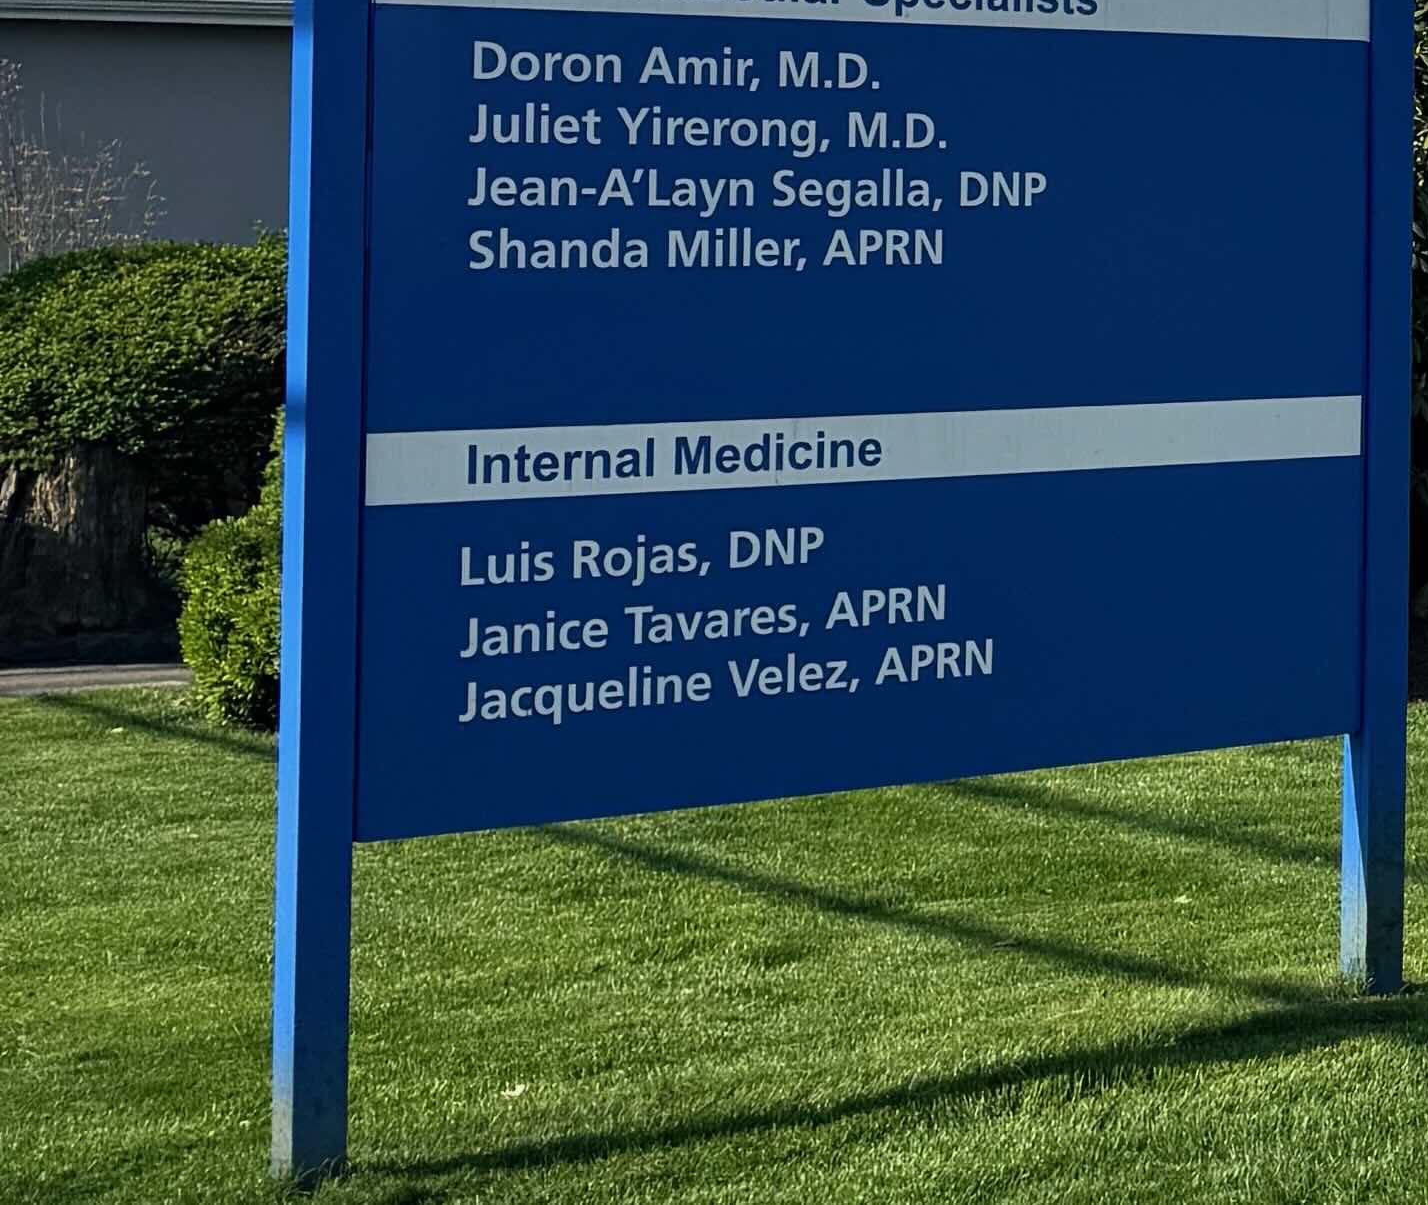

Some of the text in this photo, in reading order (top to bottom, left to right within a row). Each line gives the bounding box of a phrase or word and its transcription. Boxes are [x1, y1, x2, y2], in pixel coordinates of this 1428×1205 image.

[473, 40, 880, 92] Doron Amir, M.D.
[469, 102, 947, 158] Juliet Yirerong, M.D.
[467, 166, 1047, 218] Jean-A’Layn Segalla, DNP
[469, 226, 943, 272] Shanda Miller, APRN
[467, 430, 883, 485] Internal Medicine
[460, 526, 825, 587] Luis Rojas, DNP
[460, 584, 946, 658] Janice Tavares, APRN
[458, 638, 993, 725] Jacqueline Velez, APRN
